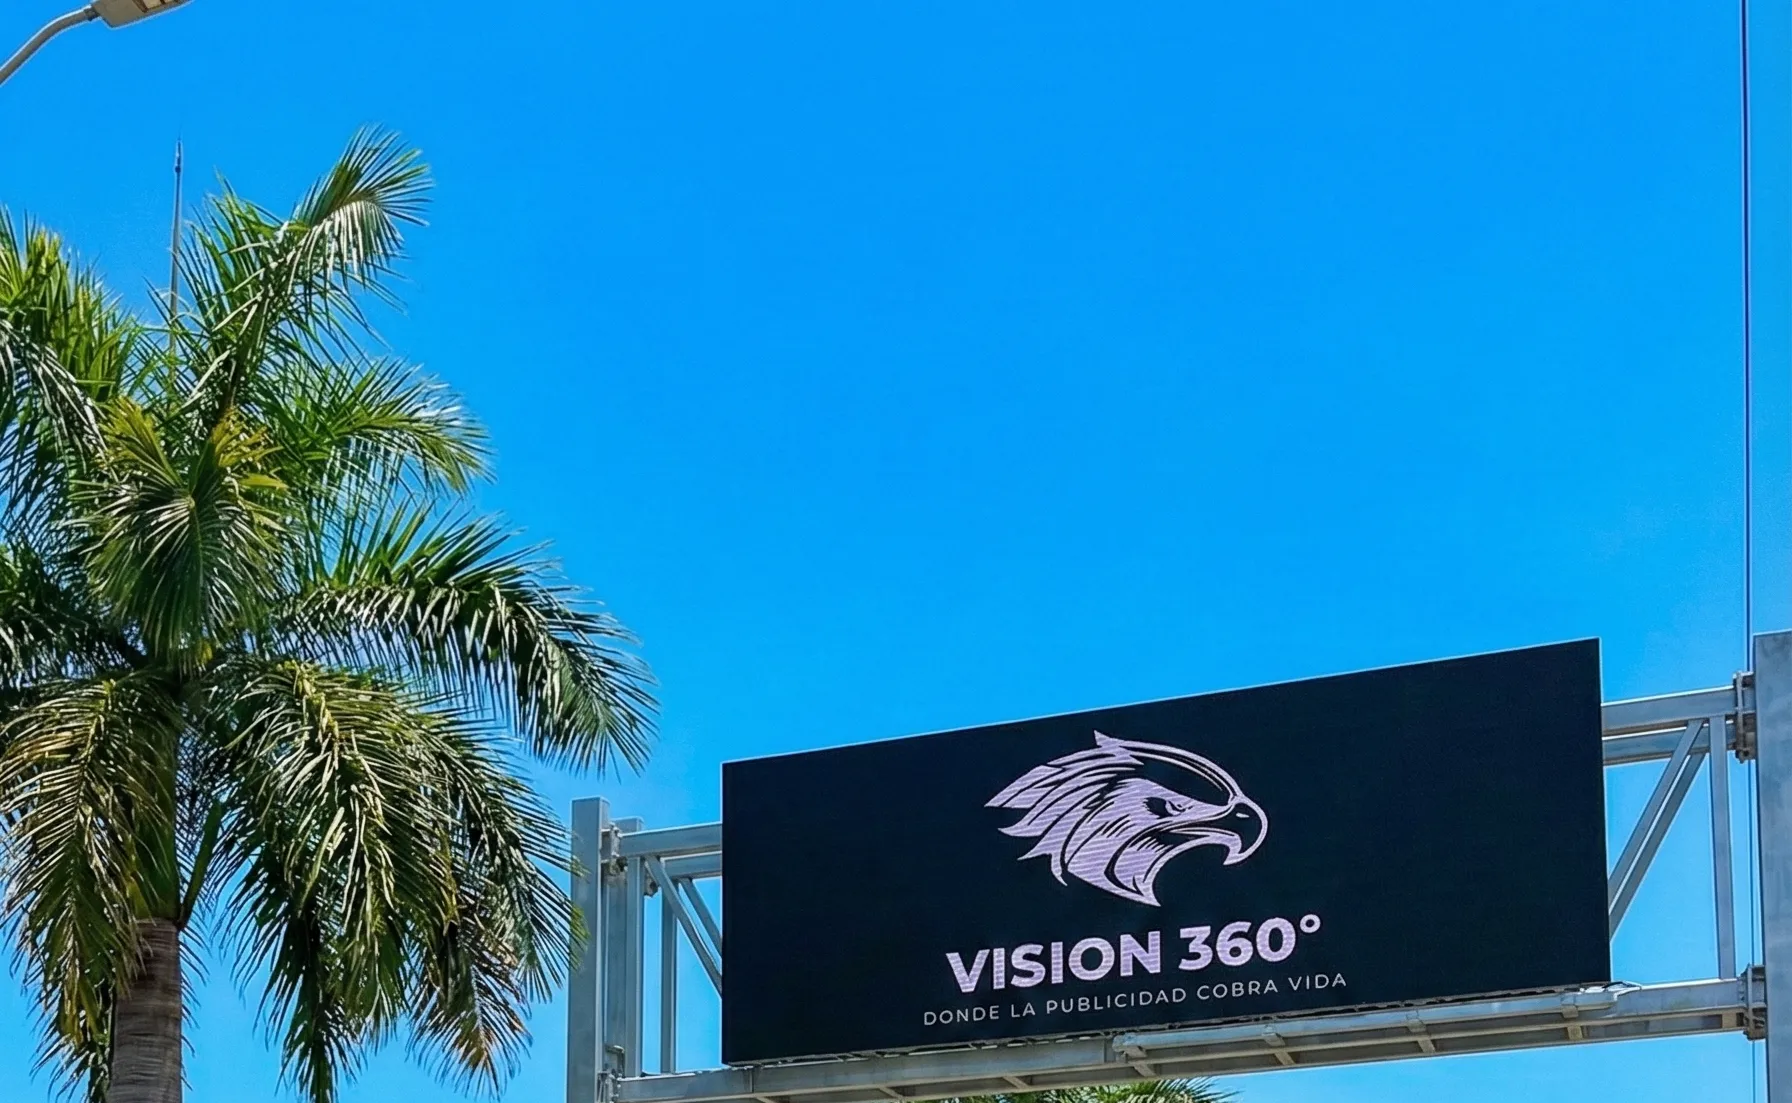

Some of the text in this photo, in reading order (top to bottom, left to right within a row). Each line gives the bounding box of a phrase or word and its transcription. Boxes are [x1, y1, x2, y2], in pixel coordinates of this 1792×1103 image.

[946, 913, 1321, 993] VISION 360°
[923, 972, 1347, 1026] DONDE LA PUBLICIDAD COBRA VIDA
